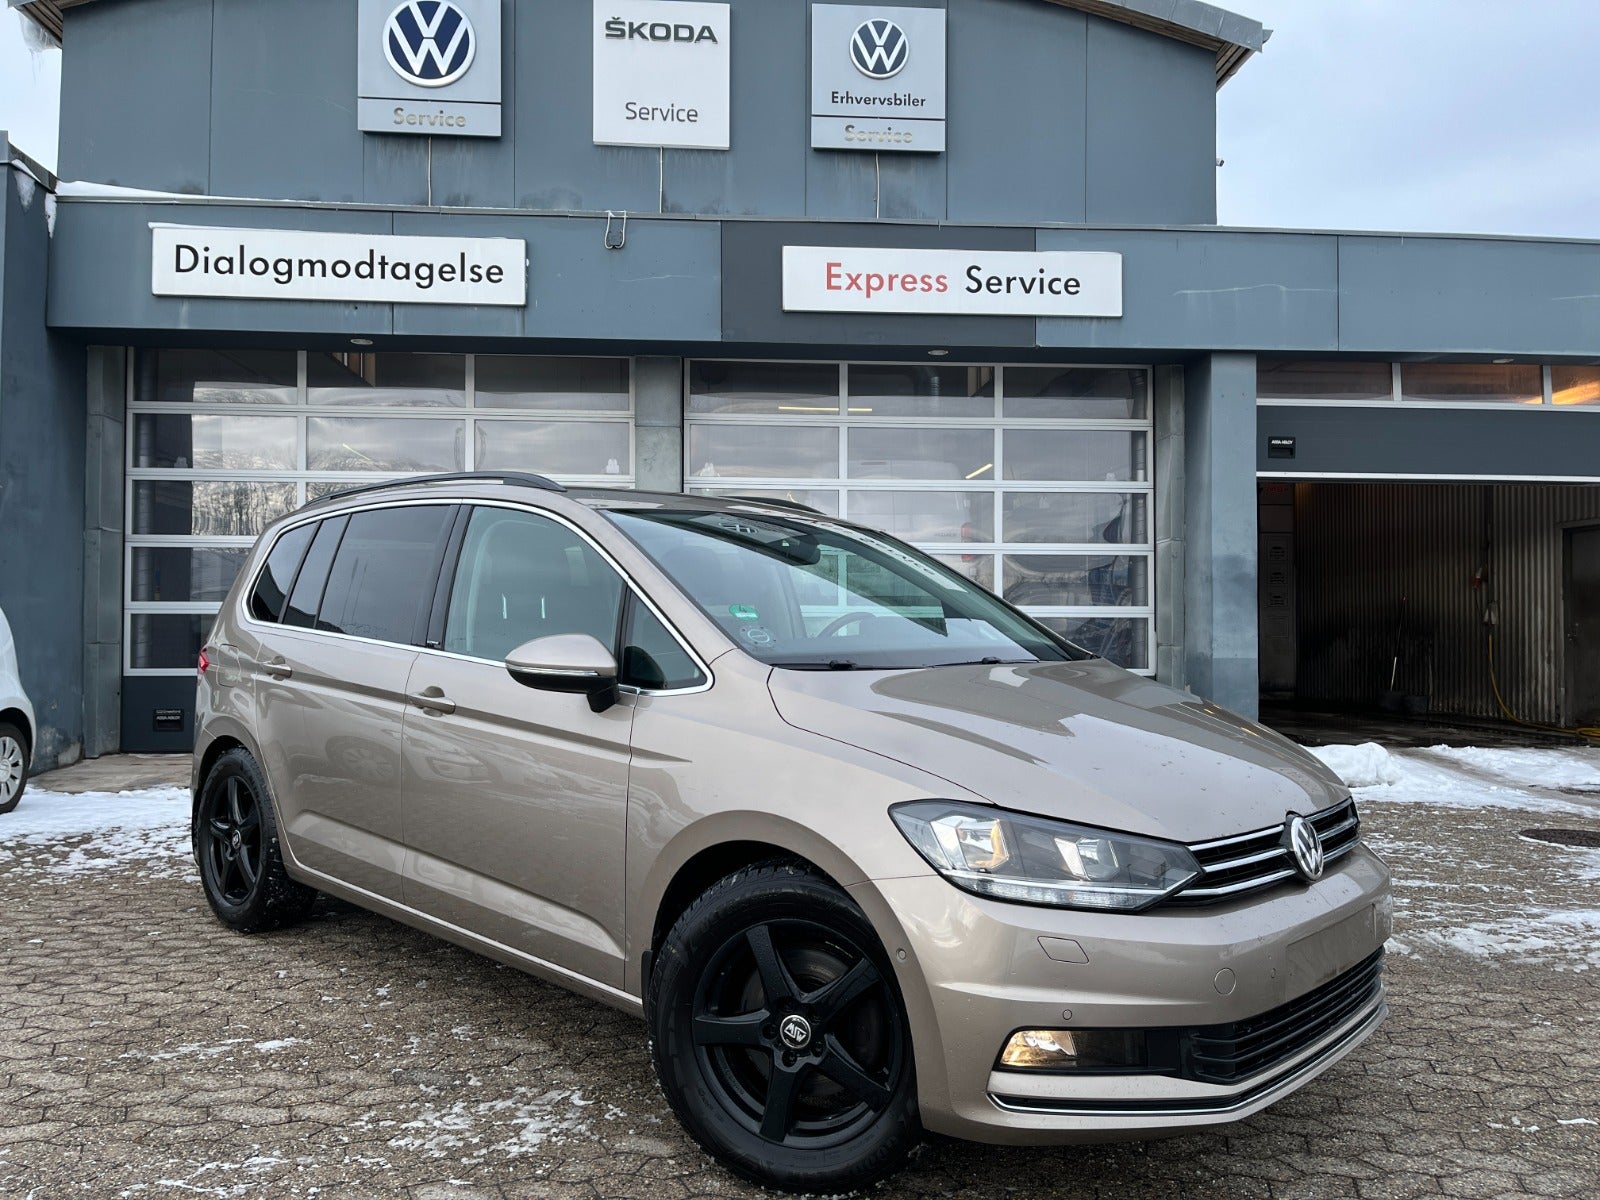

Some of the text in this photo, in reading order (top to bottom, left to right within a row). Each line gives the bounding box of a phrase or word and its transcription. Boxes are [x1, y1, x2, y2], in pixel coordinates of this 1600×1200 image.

[605, 17, 718, 44] ŠKODA
[831, 91, 926, 107] Erhvervsbiler
[393, 107, 467, 127] Service
[625, 102, 698, 122] Service
[845, 124, 913, 143] Service
[175, 244, 504, 289] Dialogmodtagelse
[825, 262, 1081, 298] Express Service
